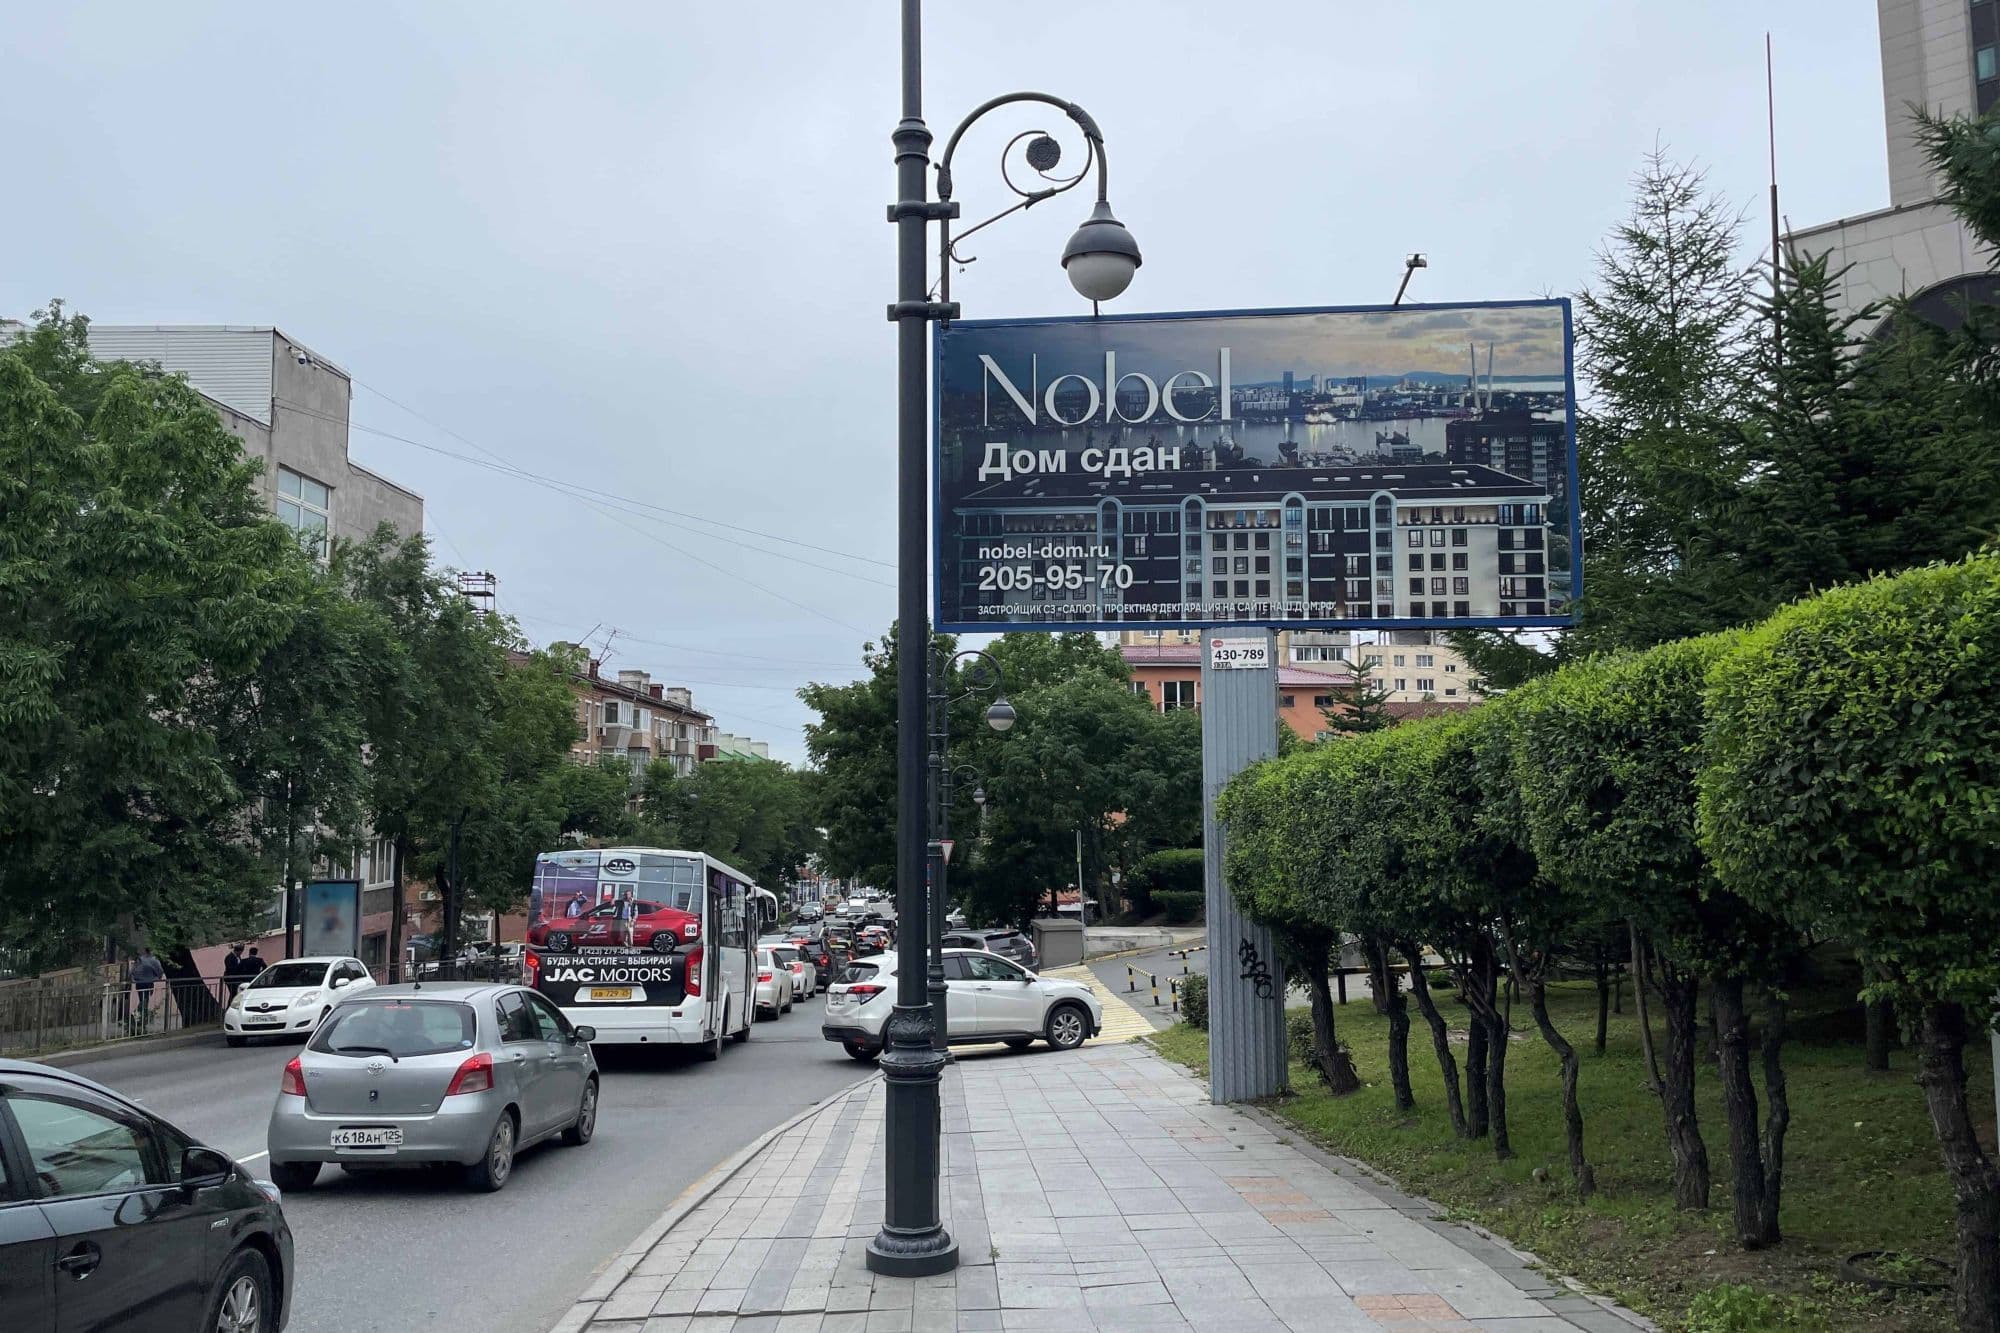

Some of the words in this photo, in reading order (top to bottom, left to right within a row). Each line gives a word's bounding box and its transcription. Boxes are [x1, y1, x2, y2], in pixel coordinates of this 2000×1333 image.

[978, 347, 1232, 426] Nobel
[978, 442, 1067, 482] Дом
[1080, 446, 1181, 478] сдан
[978, 543, 1109, 560] nobel-dom.ru
[978, 564, 1133, 591] 205-95-70
[977, 602, 1041, 615] ЗАСТРОЙЩИК
[1104, 602, 1157, 614] ПРОЕКТНАЯ
[1159, 602, 1221, 615] ДЕКЛАРАЦИЯ
[1223, 602, 1235, 612] НА
[1237, 600, 1268, 612] САЙТЕ
[1214, 649, 1264, 660] 430-789
[686, 926, 697, 934] 68
[547, 957, 570, 966] БУДЬ
[572, 957, 585, 965] НА
[587, 957, 617, 965] СТИЛЕ
[628, 955, 672, 965] ВЫБИРАЙ
[545, 968, 595, 981] JAC
[600, 968, 671, 981] MOTORS
